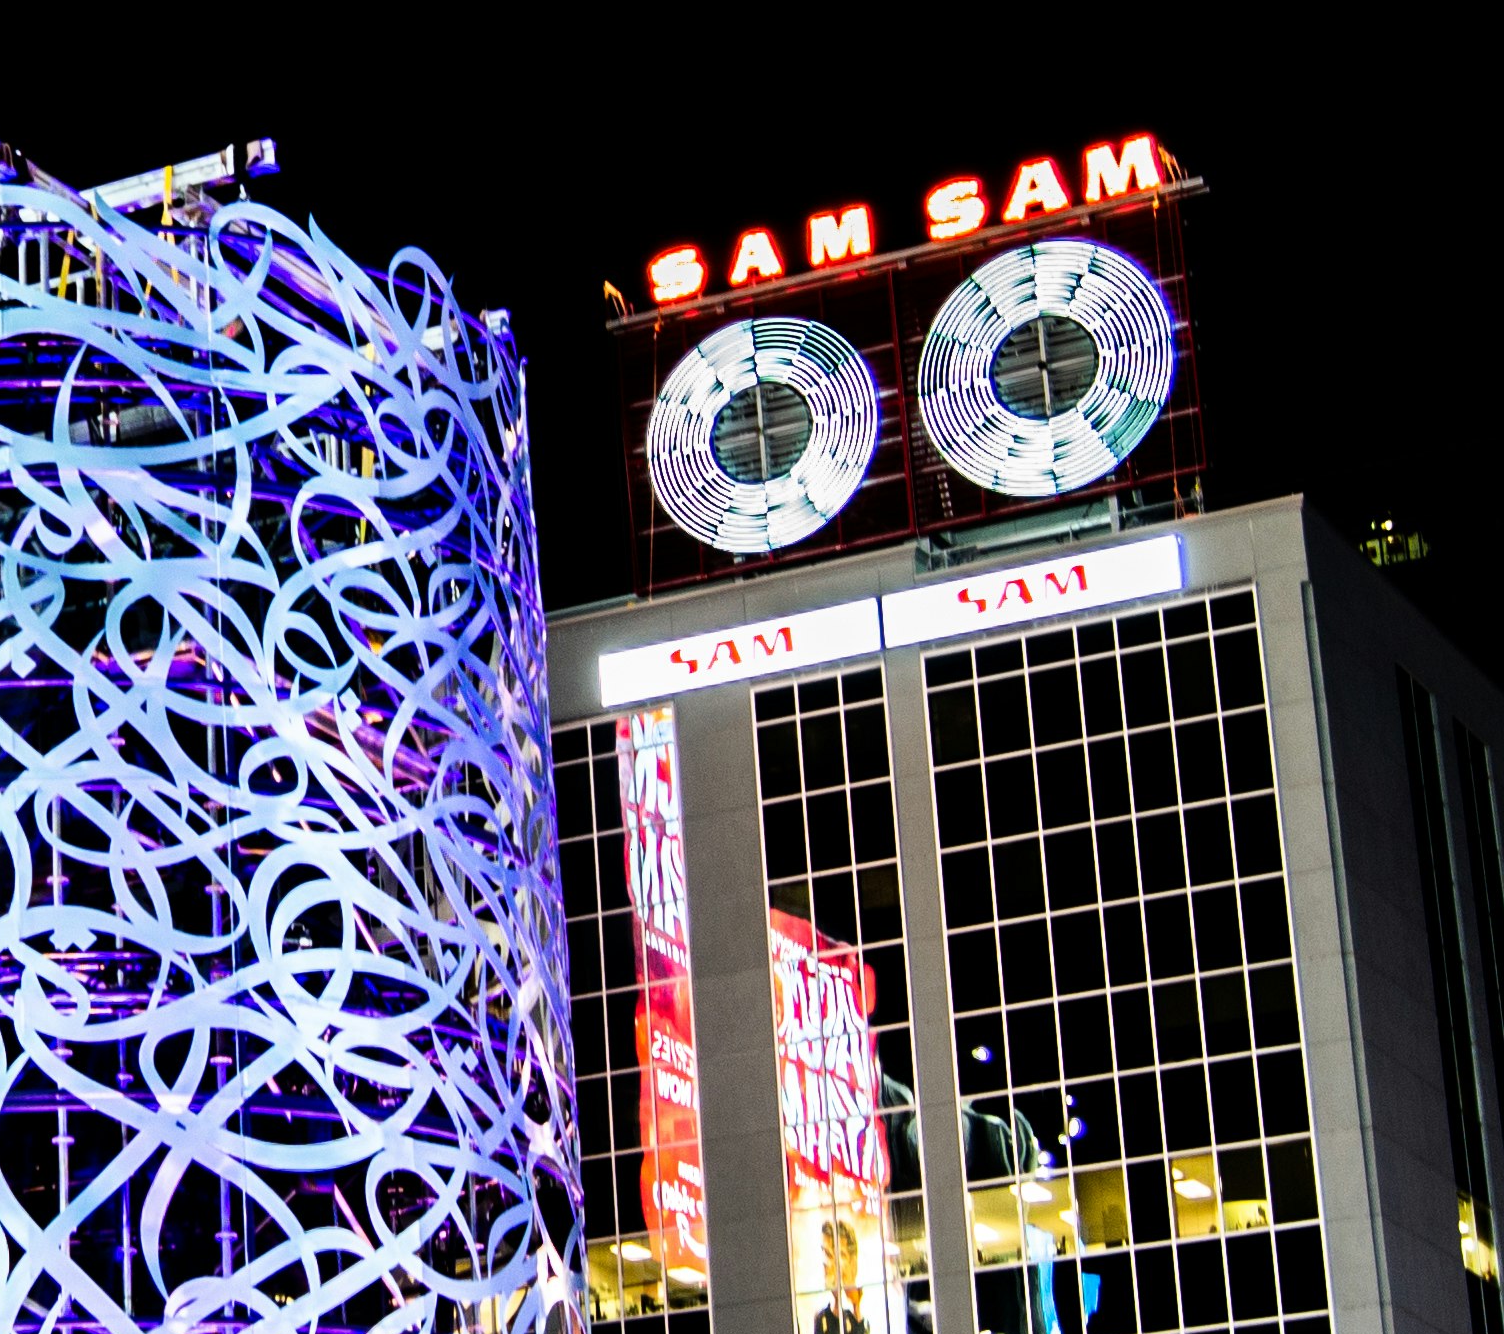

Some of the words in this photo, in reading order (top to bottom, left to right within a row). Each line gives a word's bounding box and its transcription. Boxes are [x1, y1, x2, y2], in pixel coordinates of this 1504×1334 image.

[647, 204, 872, 302] SAM
[926, 133, 1161, 240] SAM
[956, 564, 1088, 614] SAM
[670, 626, 794, 674] SAM
